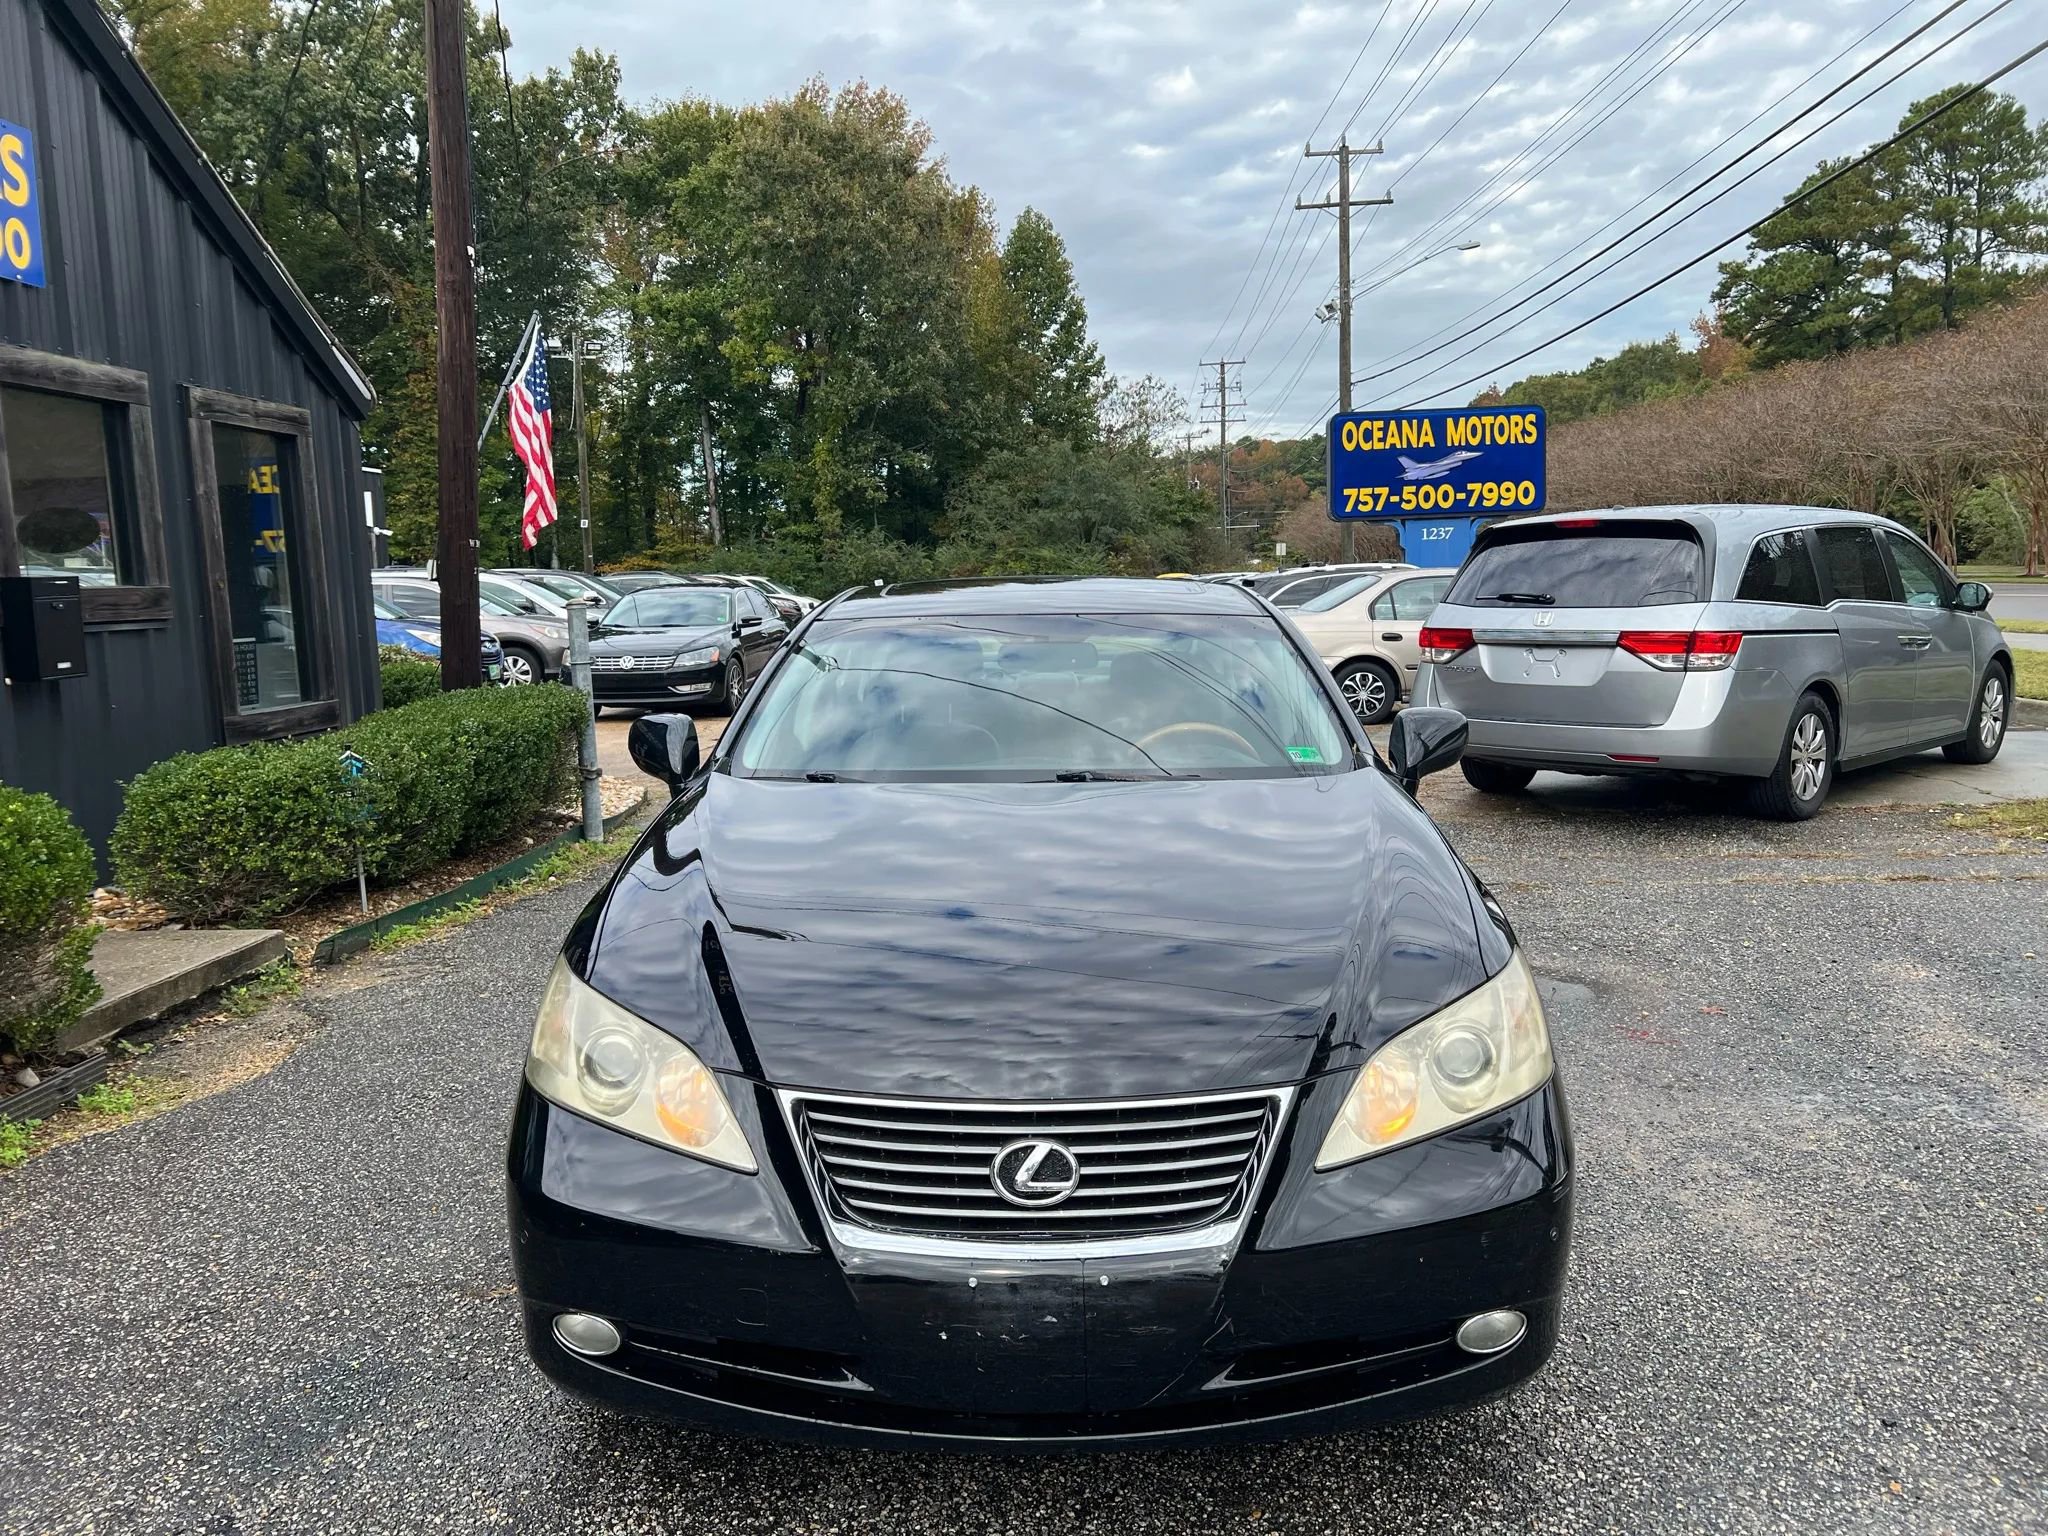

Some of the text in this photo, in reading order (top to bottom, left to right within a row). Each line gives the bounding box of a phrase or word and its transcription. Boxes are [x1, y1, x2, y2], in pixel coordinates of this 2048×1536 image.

[0, 217, 31, 270] 0
[1342, 413, 1538, 451] OCEANA MOTORS
[1343, 481, 1536, 512] 757-500-7990
[1421, 527, 1454, 541] 1237
